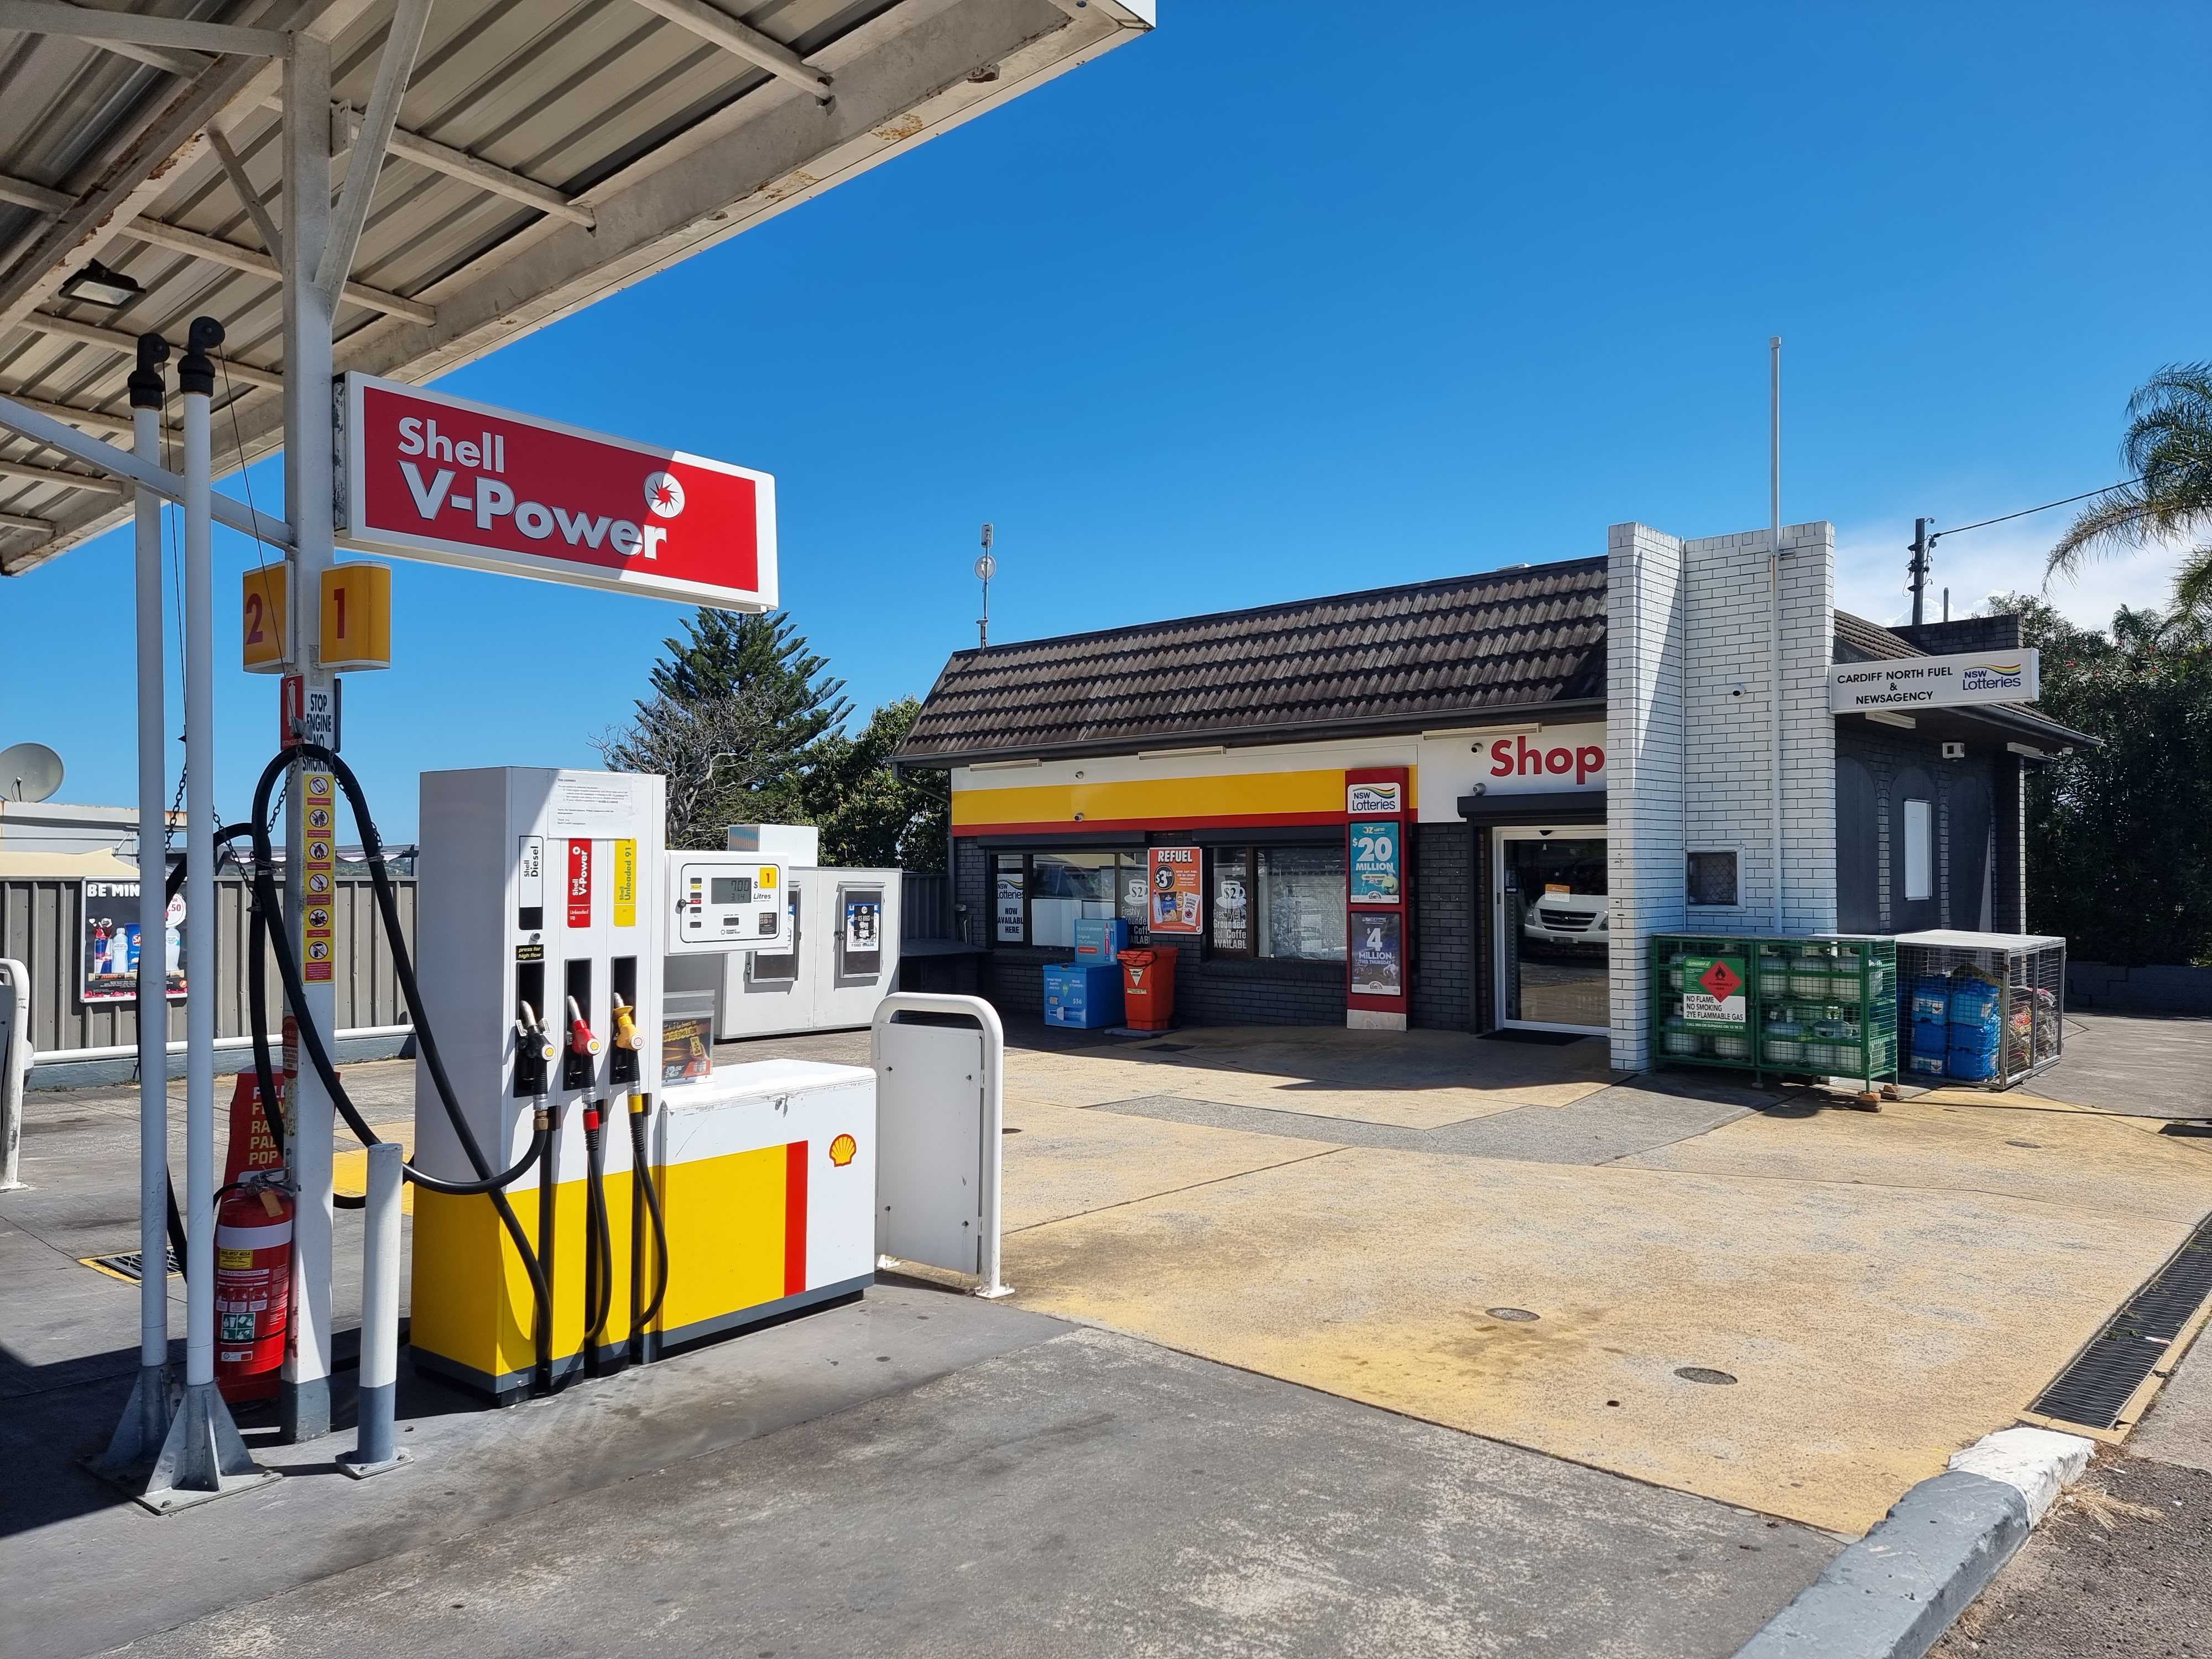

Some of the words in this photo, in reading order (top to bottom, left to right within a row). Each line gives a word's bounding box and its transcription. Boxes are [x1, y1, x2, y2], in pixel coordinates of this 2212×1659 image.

[398, 416, 505, 473] Shell
[397, 460, 667, 561] V-Power
[246, 593, 263, 645] 2
[333, 588, 345, 639] 1
[1837, 672, 1883, 685] CARDIFF
[1886, 668, 1924, 680] NORTH
[1928, 666, 1953, 677] FUEL
[1964, 670, 1987, 679] NSW
[1889, 682, 1898, 691] &
[1963, 676, 2021, 691] Lotteries
[310, 693, 327, 713] STOP
[1855, 691, 1934, 705] NEWSAGENCY
[306, 713, 332, 733] ENGINE
[313, 734, 325, 748] NO
[302, 757, 330, 772] SMOKIN
[1490, 736, 1605, 785] Shop
[1352, 799, 1396, 811] Lotteries
[625, 847, 632, 858] 91
[1157, 850, 1193, 863] REFUEL
[530, 846, 539, 878] Diesel
[1355, 862, 1394, 871] MILLION
[579, 849, 588, 896] V-Power
[766, 873, 770, 883] 1
[87, 884, 107, 897] BE
[112, 884, 140, 897] MIN
[1131, 886, 1143, 898] $2
[1224, 887, 1237, 899] $2
[168, 904, 181, 912] .50
[1121, 906, 1140, 917] Freshly
[1213, 909, 1234, 920] Freshly
[1227, 929, 1246, 939] Coffe
[1213, 939, 1247, 950] AVAILABL
[1359, 951, 1392, 960] MILLION
[249, 1150, 278, 1165] POP
